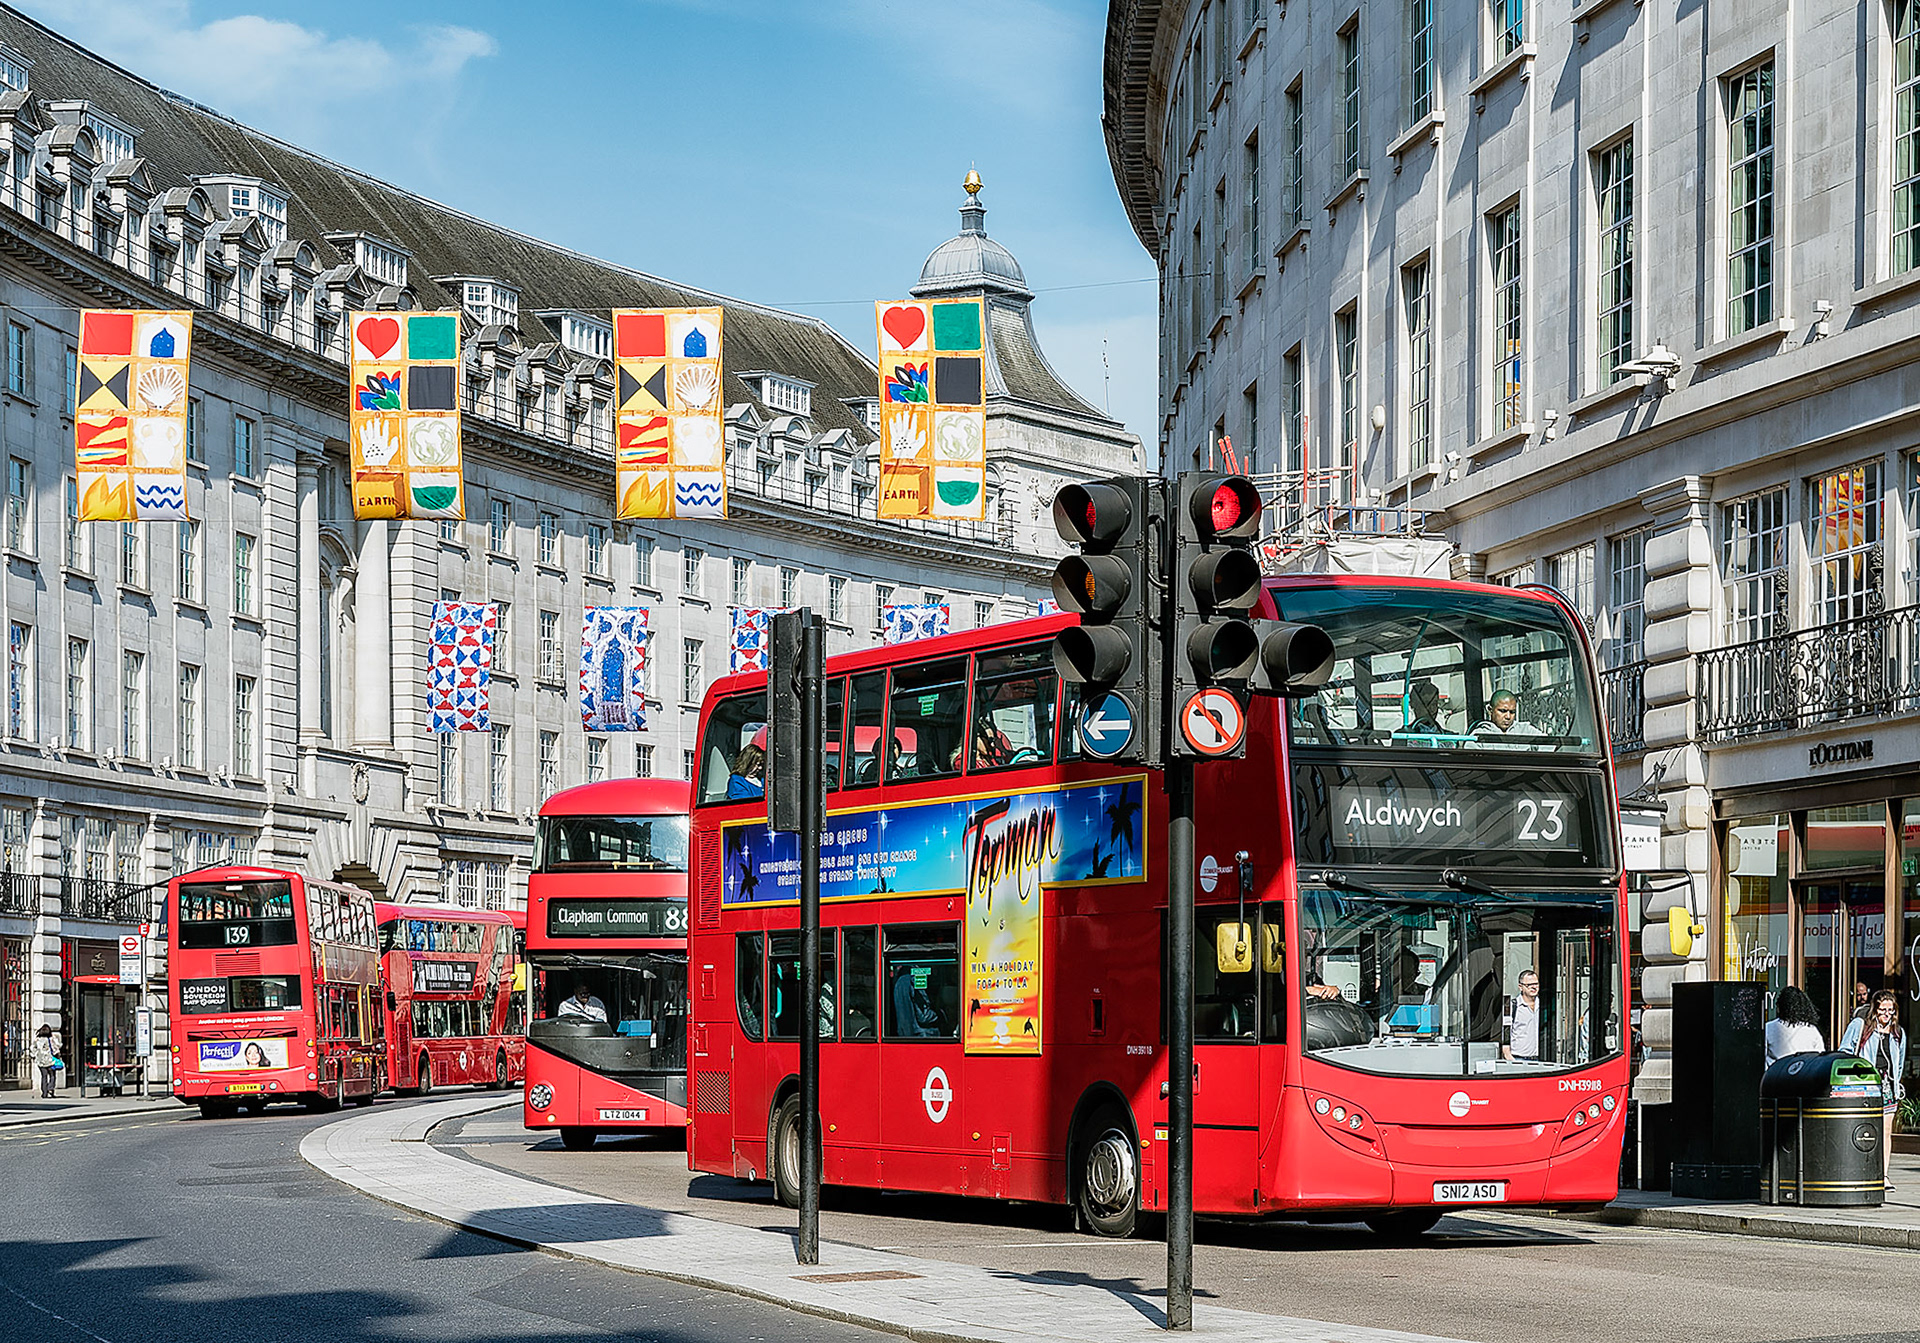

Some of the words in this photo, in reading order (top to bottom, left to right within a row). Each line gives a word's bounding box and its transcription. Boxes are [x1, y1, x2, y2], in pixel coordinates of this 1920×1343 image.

[359, 496, 395, 507] EARTH
[884, 489, 919, 500] EARTH
[1344, 798, 1462, 834] Aldwych
[1517, 799, 1564, 841] 23
[836, 829, 868, 845] CIRCUS
[890, 849, 917, 863] CHANGE
[962, 797, 1063, 914] Topman
[558, 907, 602, 927] Clapham
[606, 907, 648, 924] Common
[141, 925, 147, 933] E
[226, 926, 249, 944] 139
[971, 963, 987, 973] WIN
[990, 963, 995, 973] A
[998, 961, 1034, 972] HOLIDAY
[183, 985, 226, 994] LONDON
[976, 979, 992, 990] FOR
[995, 979, 1000, 989] 4
[1003, 979, 1013, 988] TO
[1016, 977, 1028, 988] LA
[202, 1043, 235, 1058] Perfectil
[1558, 1079, 1602, 1092] DNH39118
[1441, 1185, 1469, 1199] SN12
[1472, 1185, 1497, 1199] ASO
